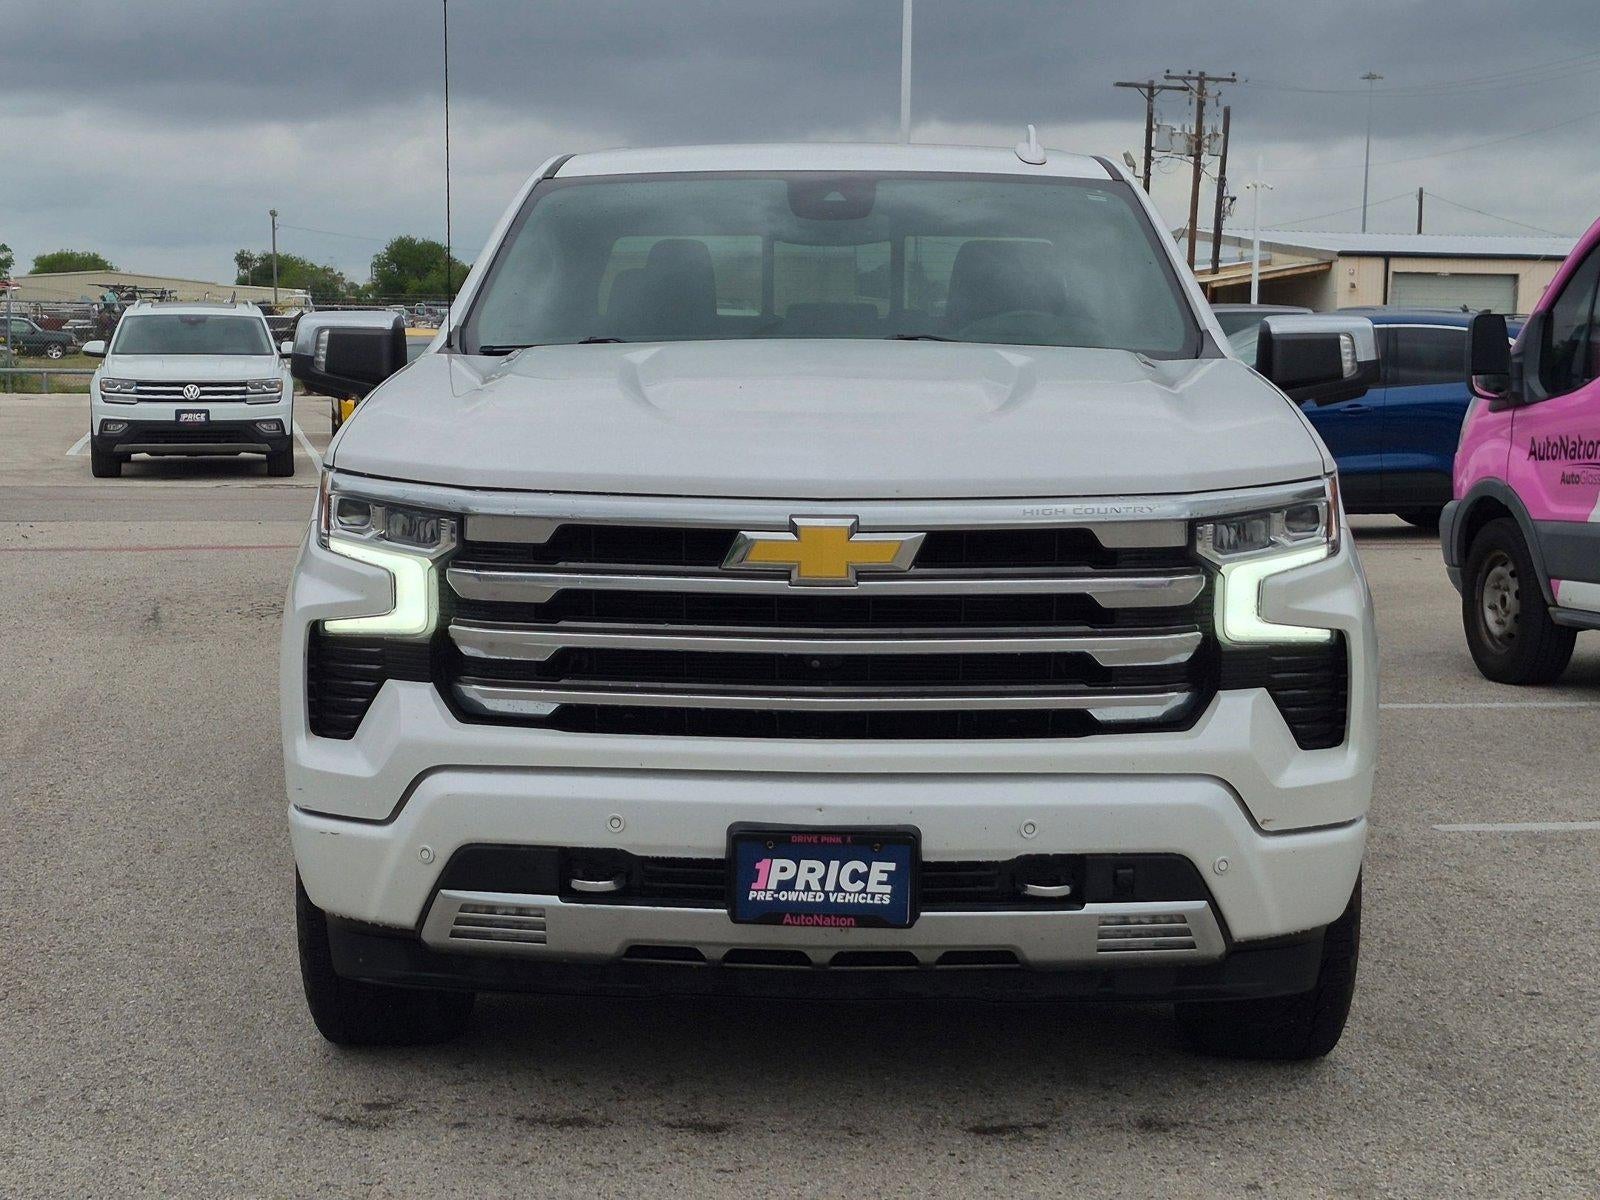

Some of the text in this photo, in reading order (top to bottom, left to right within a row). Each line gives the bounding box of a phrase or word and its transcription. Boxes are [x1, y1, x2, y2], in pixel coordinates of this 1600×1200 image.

[1022, 506, 1157, 516] HIGH COUNTRY
[791, 834, 842, 844] DRIVE PINK
[748, 890, 891, 905] PRE-OWNED VEHICLES
[782, 912, 856, 927] AutoNation
